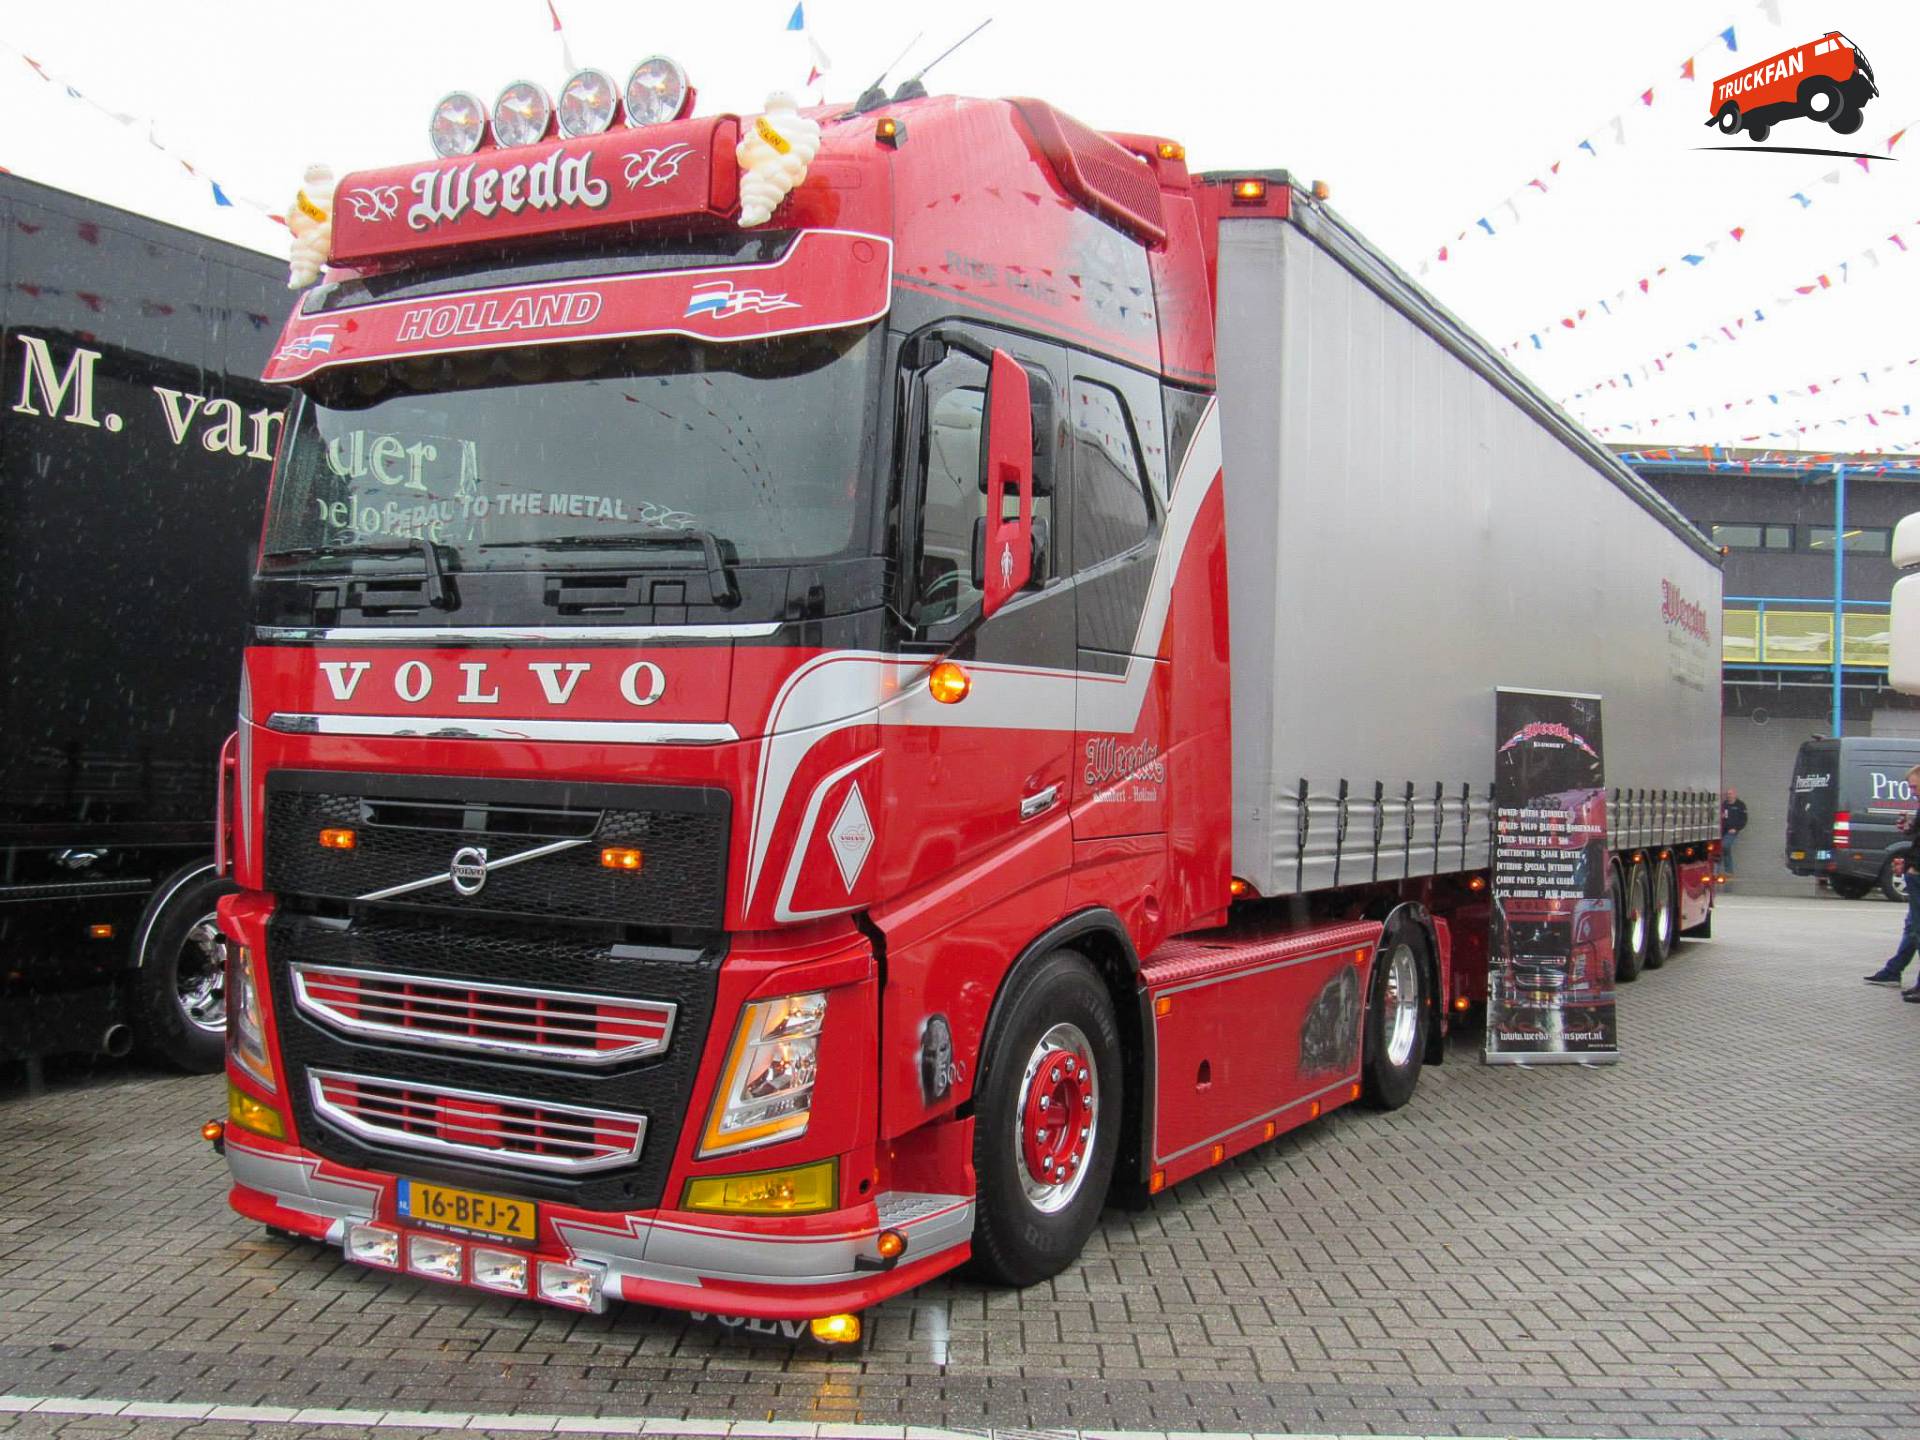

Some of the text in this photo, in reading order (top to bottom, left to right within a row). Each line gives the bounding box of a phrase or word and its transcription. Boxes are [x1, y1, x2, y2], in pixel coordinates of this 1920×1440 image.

[407, 149, 612, 232] Weeda
[396, 291, 604, 342] HOLLAND
[12, 334, 124, 433] M.
[461, 495, 489, 519] TO
[499, 494, 543, 515] THE
[549, 494, 629, 520] METAL
[319, 660, 667, 706] VOLVO
[1084, 736, 1165, 785] Weeda
[1869, 772, 1912, 801] Pro
[452, 867, 485, 876] VOLVO
[422, 1189, 521, 1233] 16-BFJ-2
